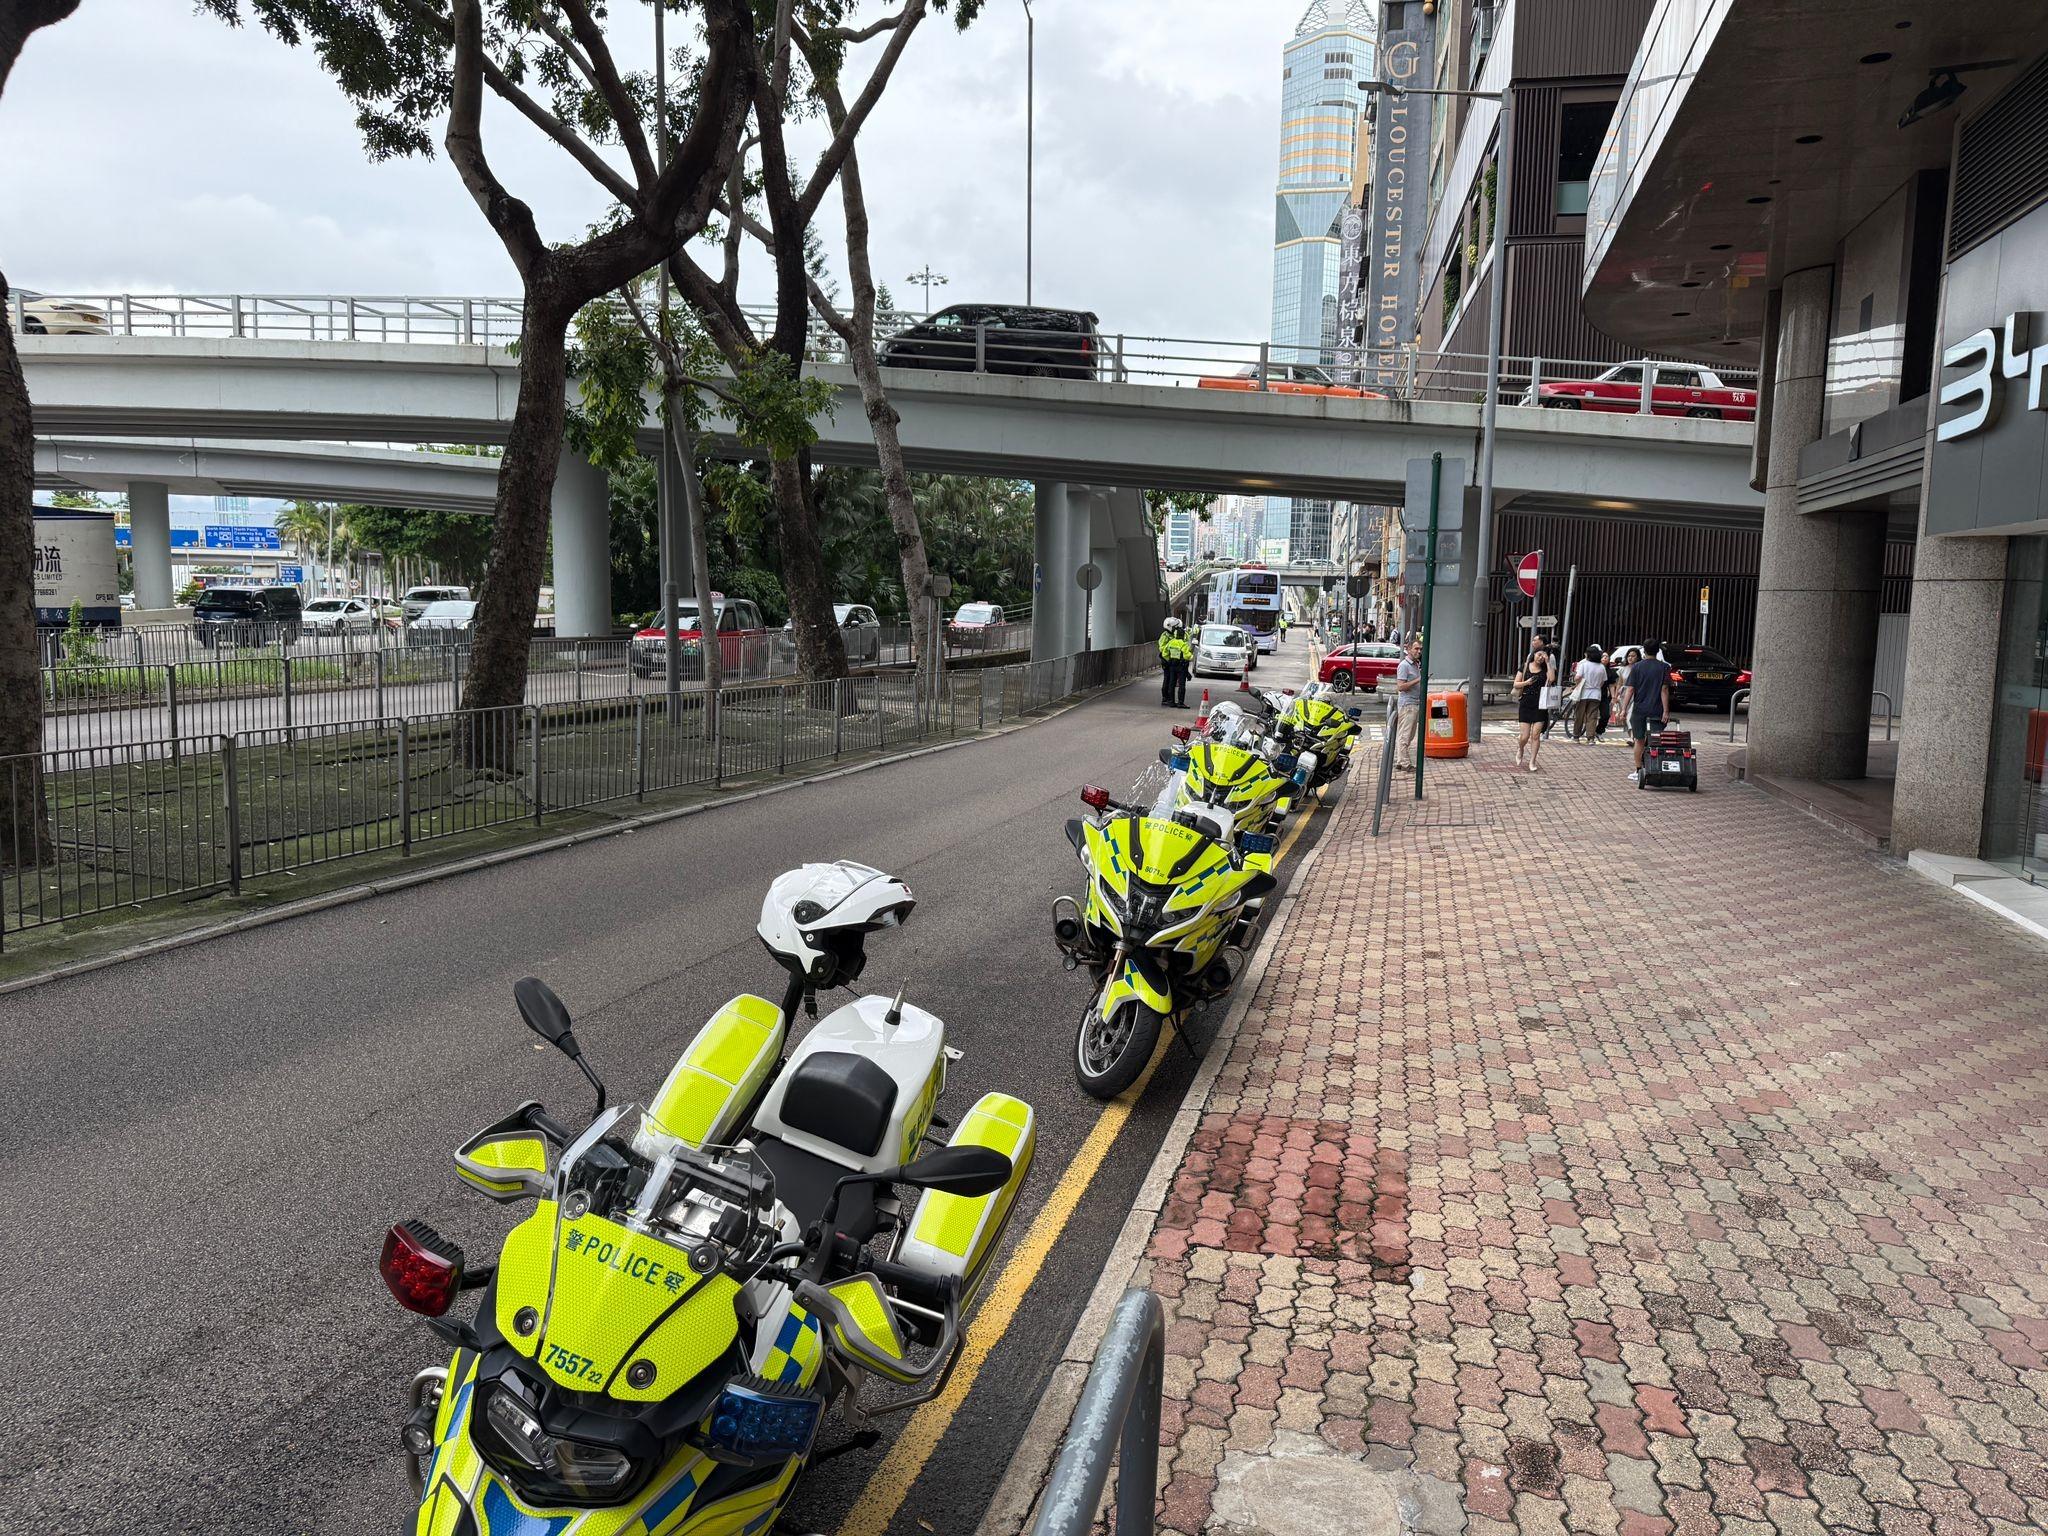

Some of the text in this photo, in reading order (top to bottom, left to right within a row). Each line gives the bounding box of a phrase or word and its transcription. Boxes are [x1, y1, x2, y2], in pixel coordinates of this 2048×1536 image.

[1378, 294, 1399, 385] HOTEL
[1220, 747, 1240, 757] POLICE
[1152, 822, 1185, 839] POLICE
[565, 1228, 585, 1251] 警
[583, 1235, 664, 1285] POLICE
[663, 1270, 685, 1295] 察
